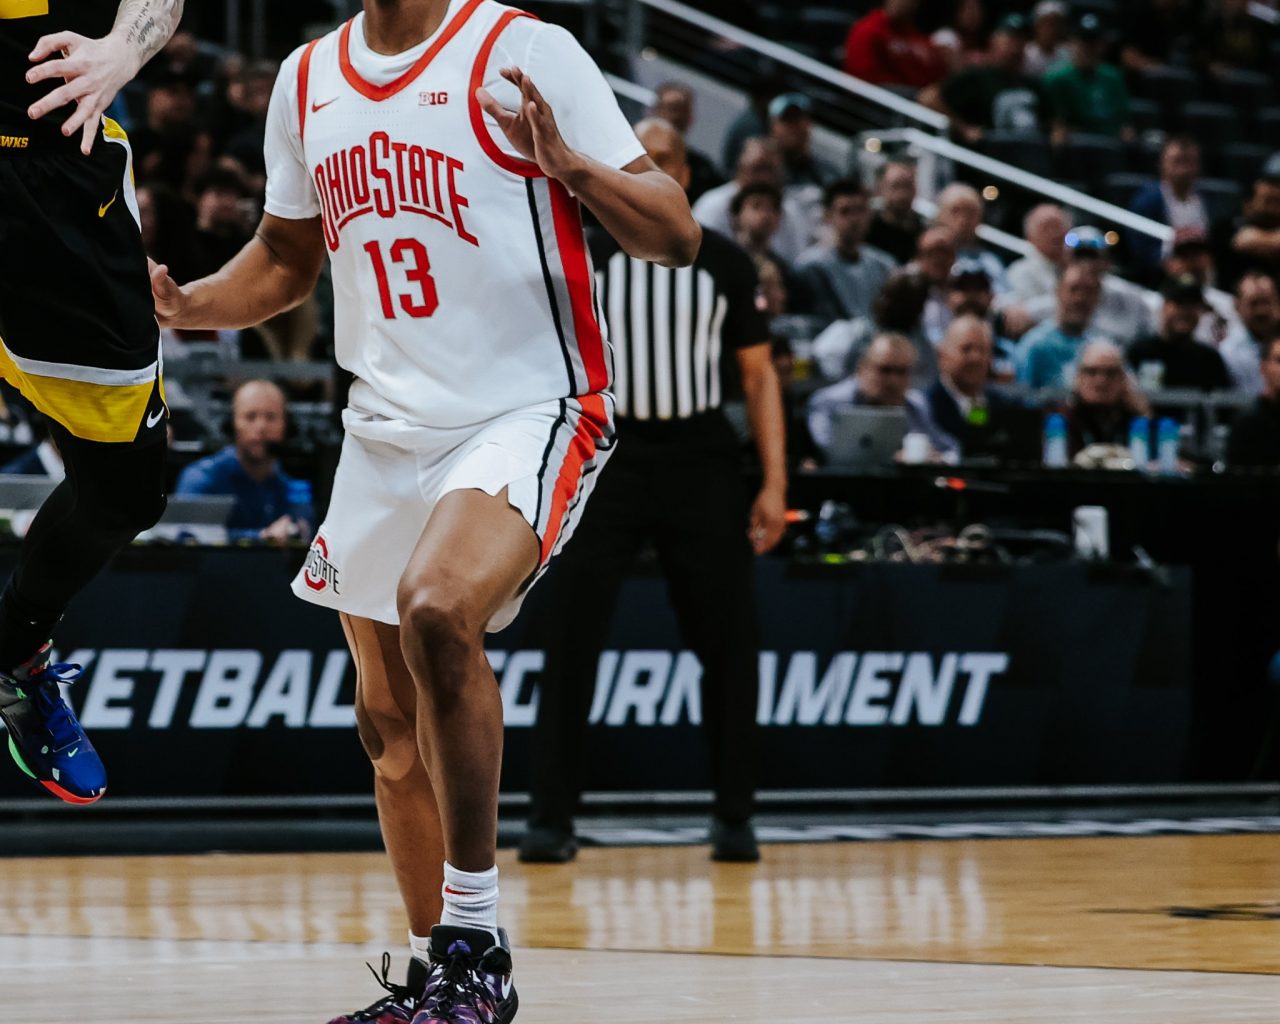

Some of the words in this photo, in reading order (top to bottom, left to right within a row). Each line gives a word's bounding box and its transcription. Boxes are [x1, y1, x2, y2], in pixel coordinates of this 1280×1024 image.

[314, 144, 371, 253] OHIO
[369, 130, 480, 248] STATE
[363, 238, 439, 320] 13
